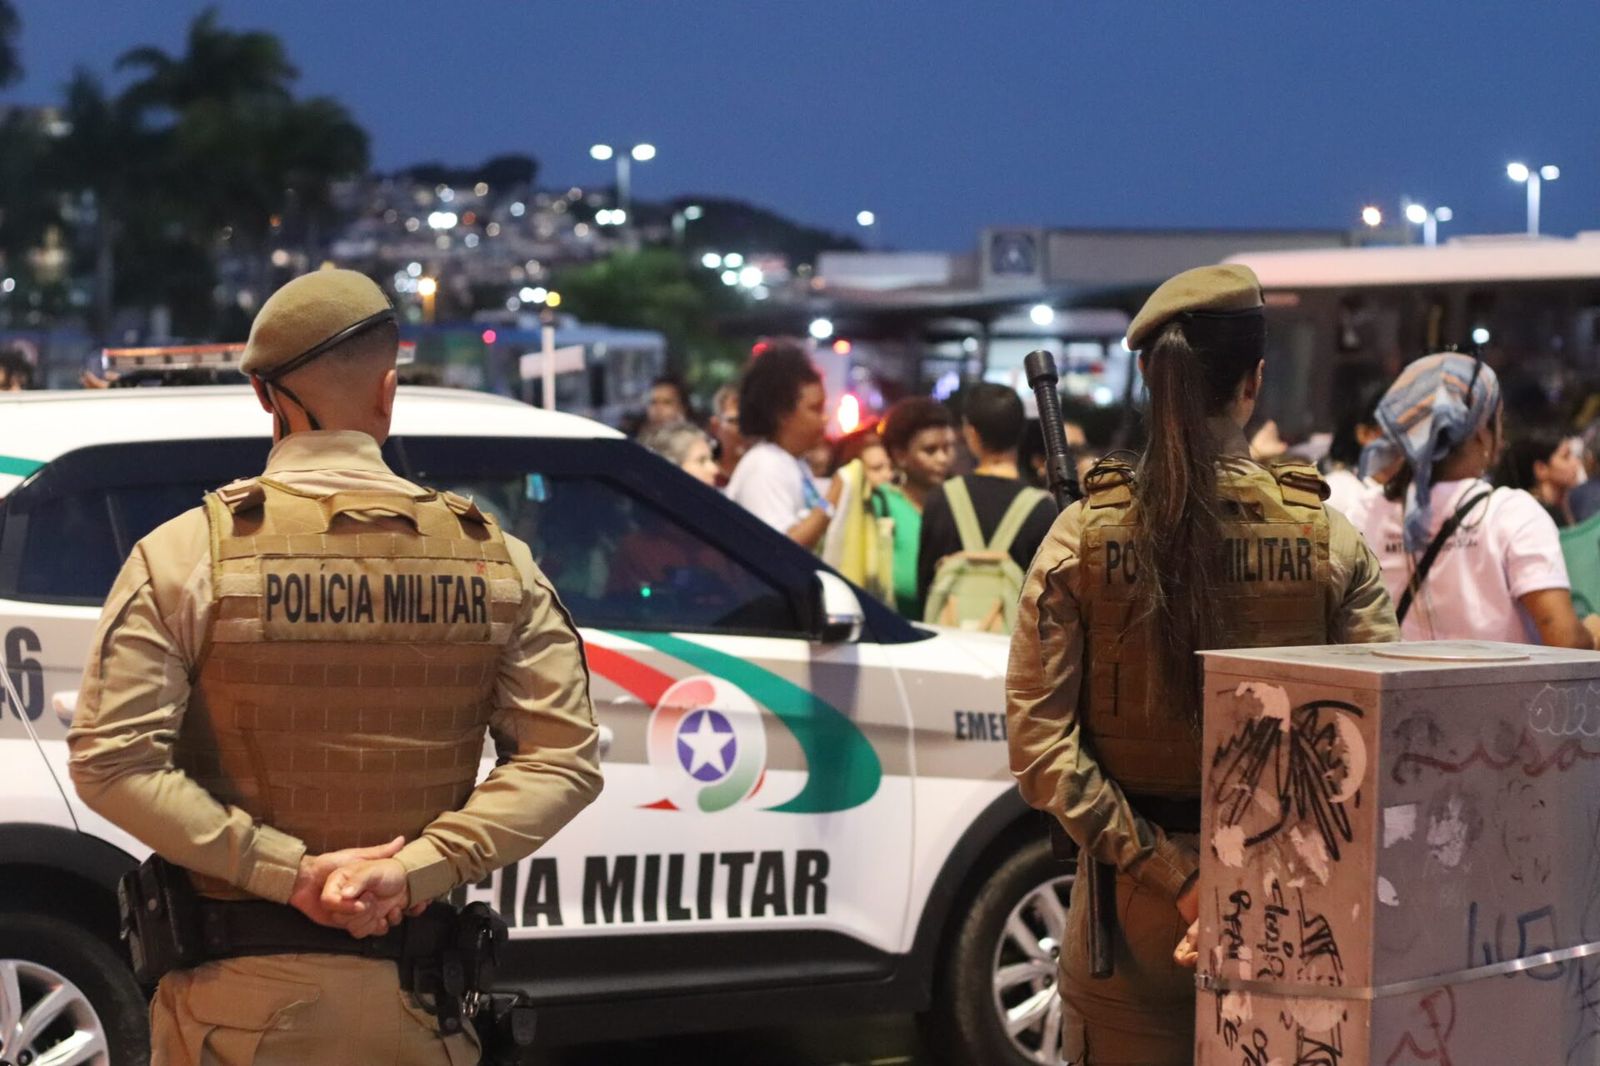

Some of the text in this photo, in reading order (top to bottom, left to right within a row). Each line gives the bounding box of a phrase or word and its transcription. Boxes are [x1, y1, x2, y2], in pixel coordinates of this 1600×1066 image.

[266, 563, 487, 624] POLÍCIA MILITAR
[0, 626, 45, 722] 6
[583, 849, 830, 925] MILITAR
